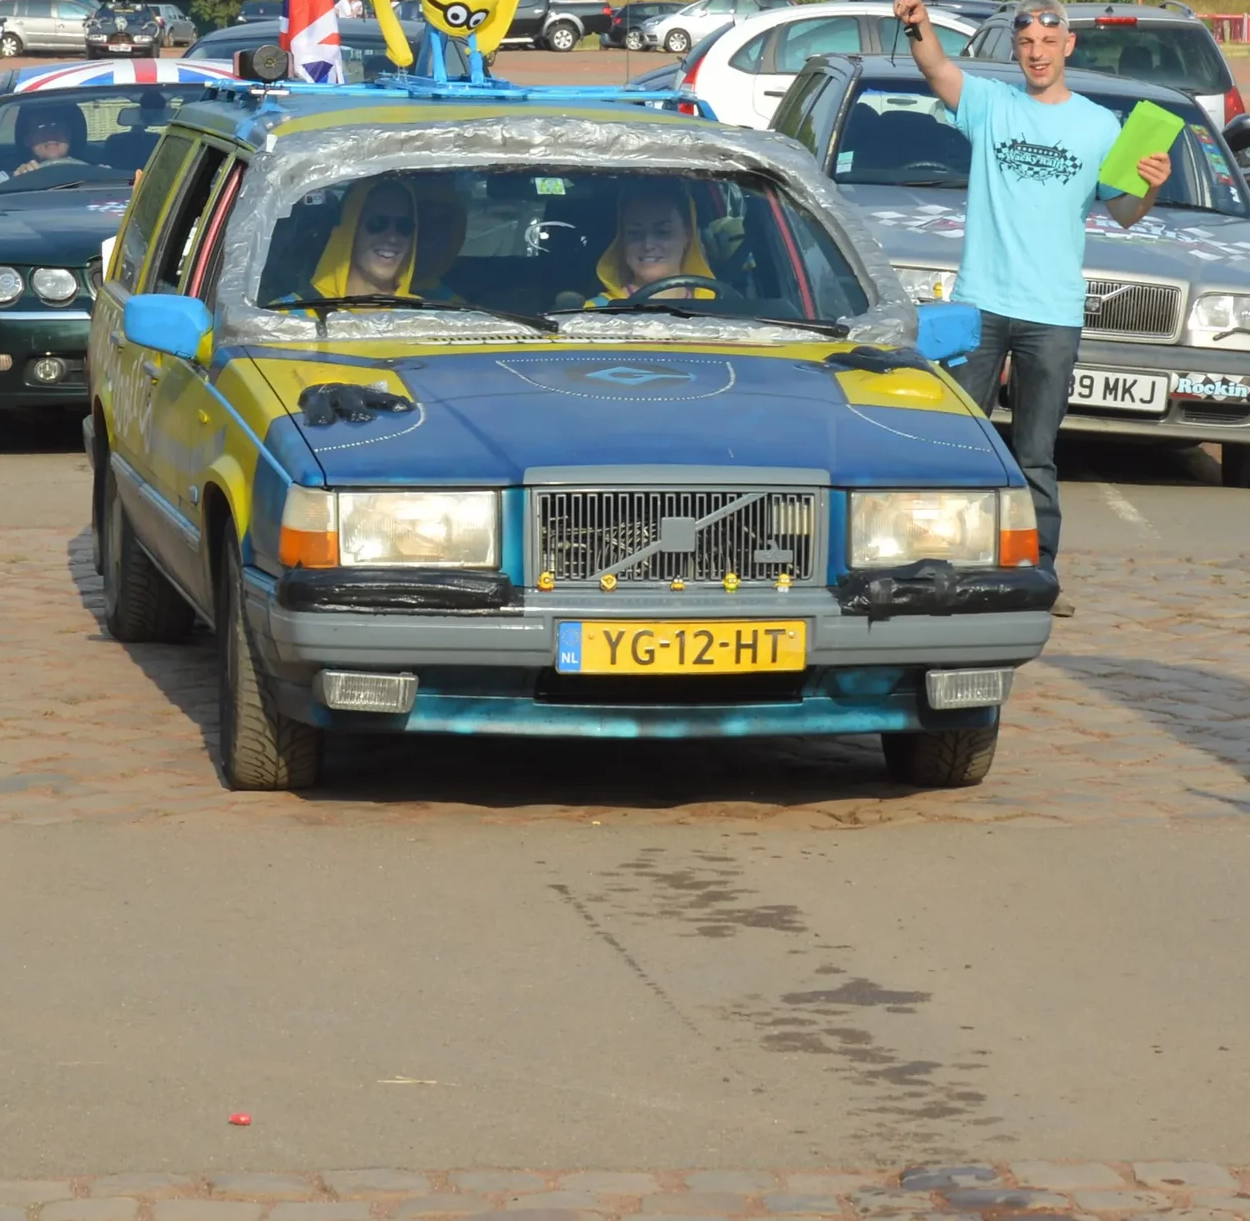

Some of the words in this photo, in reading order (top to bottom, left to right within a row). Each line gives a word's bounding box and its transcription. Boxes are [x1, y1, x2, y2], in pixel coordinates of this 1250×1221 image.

[1005, 150, 1038, 165] Wacky
[1102, 376, 1157, 405] MKJ
[1176, 377, 1249, 398] Rockin
[602, 628, 786, 666] YG-12-HT
[560, 652, 579, 665] NL
